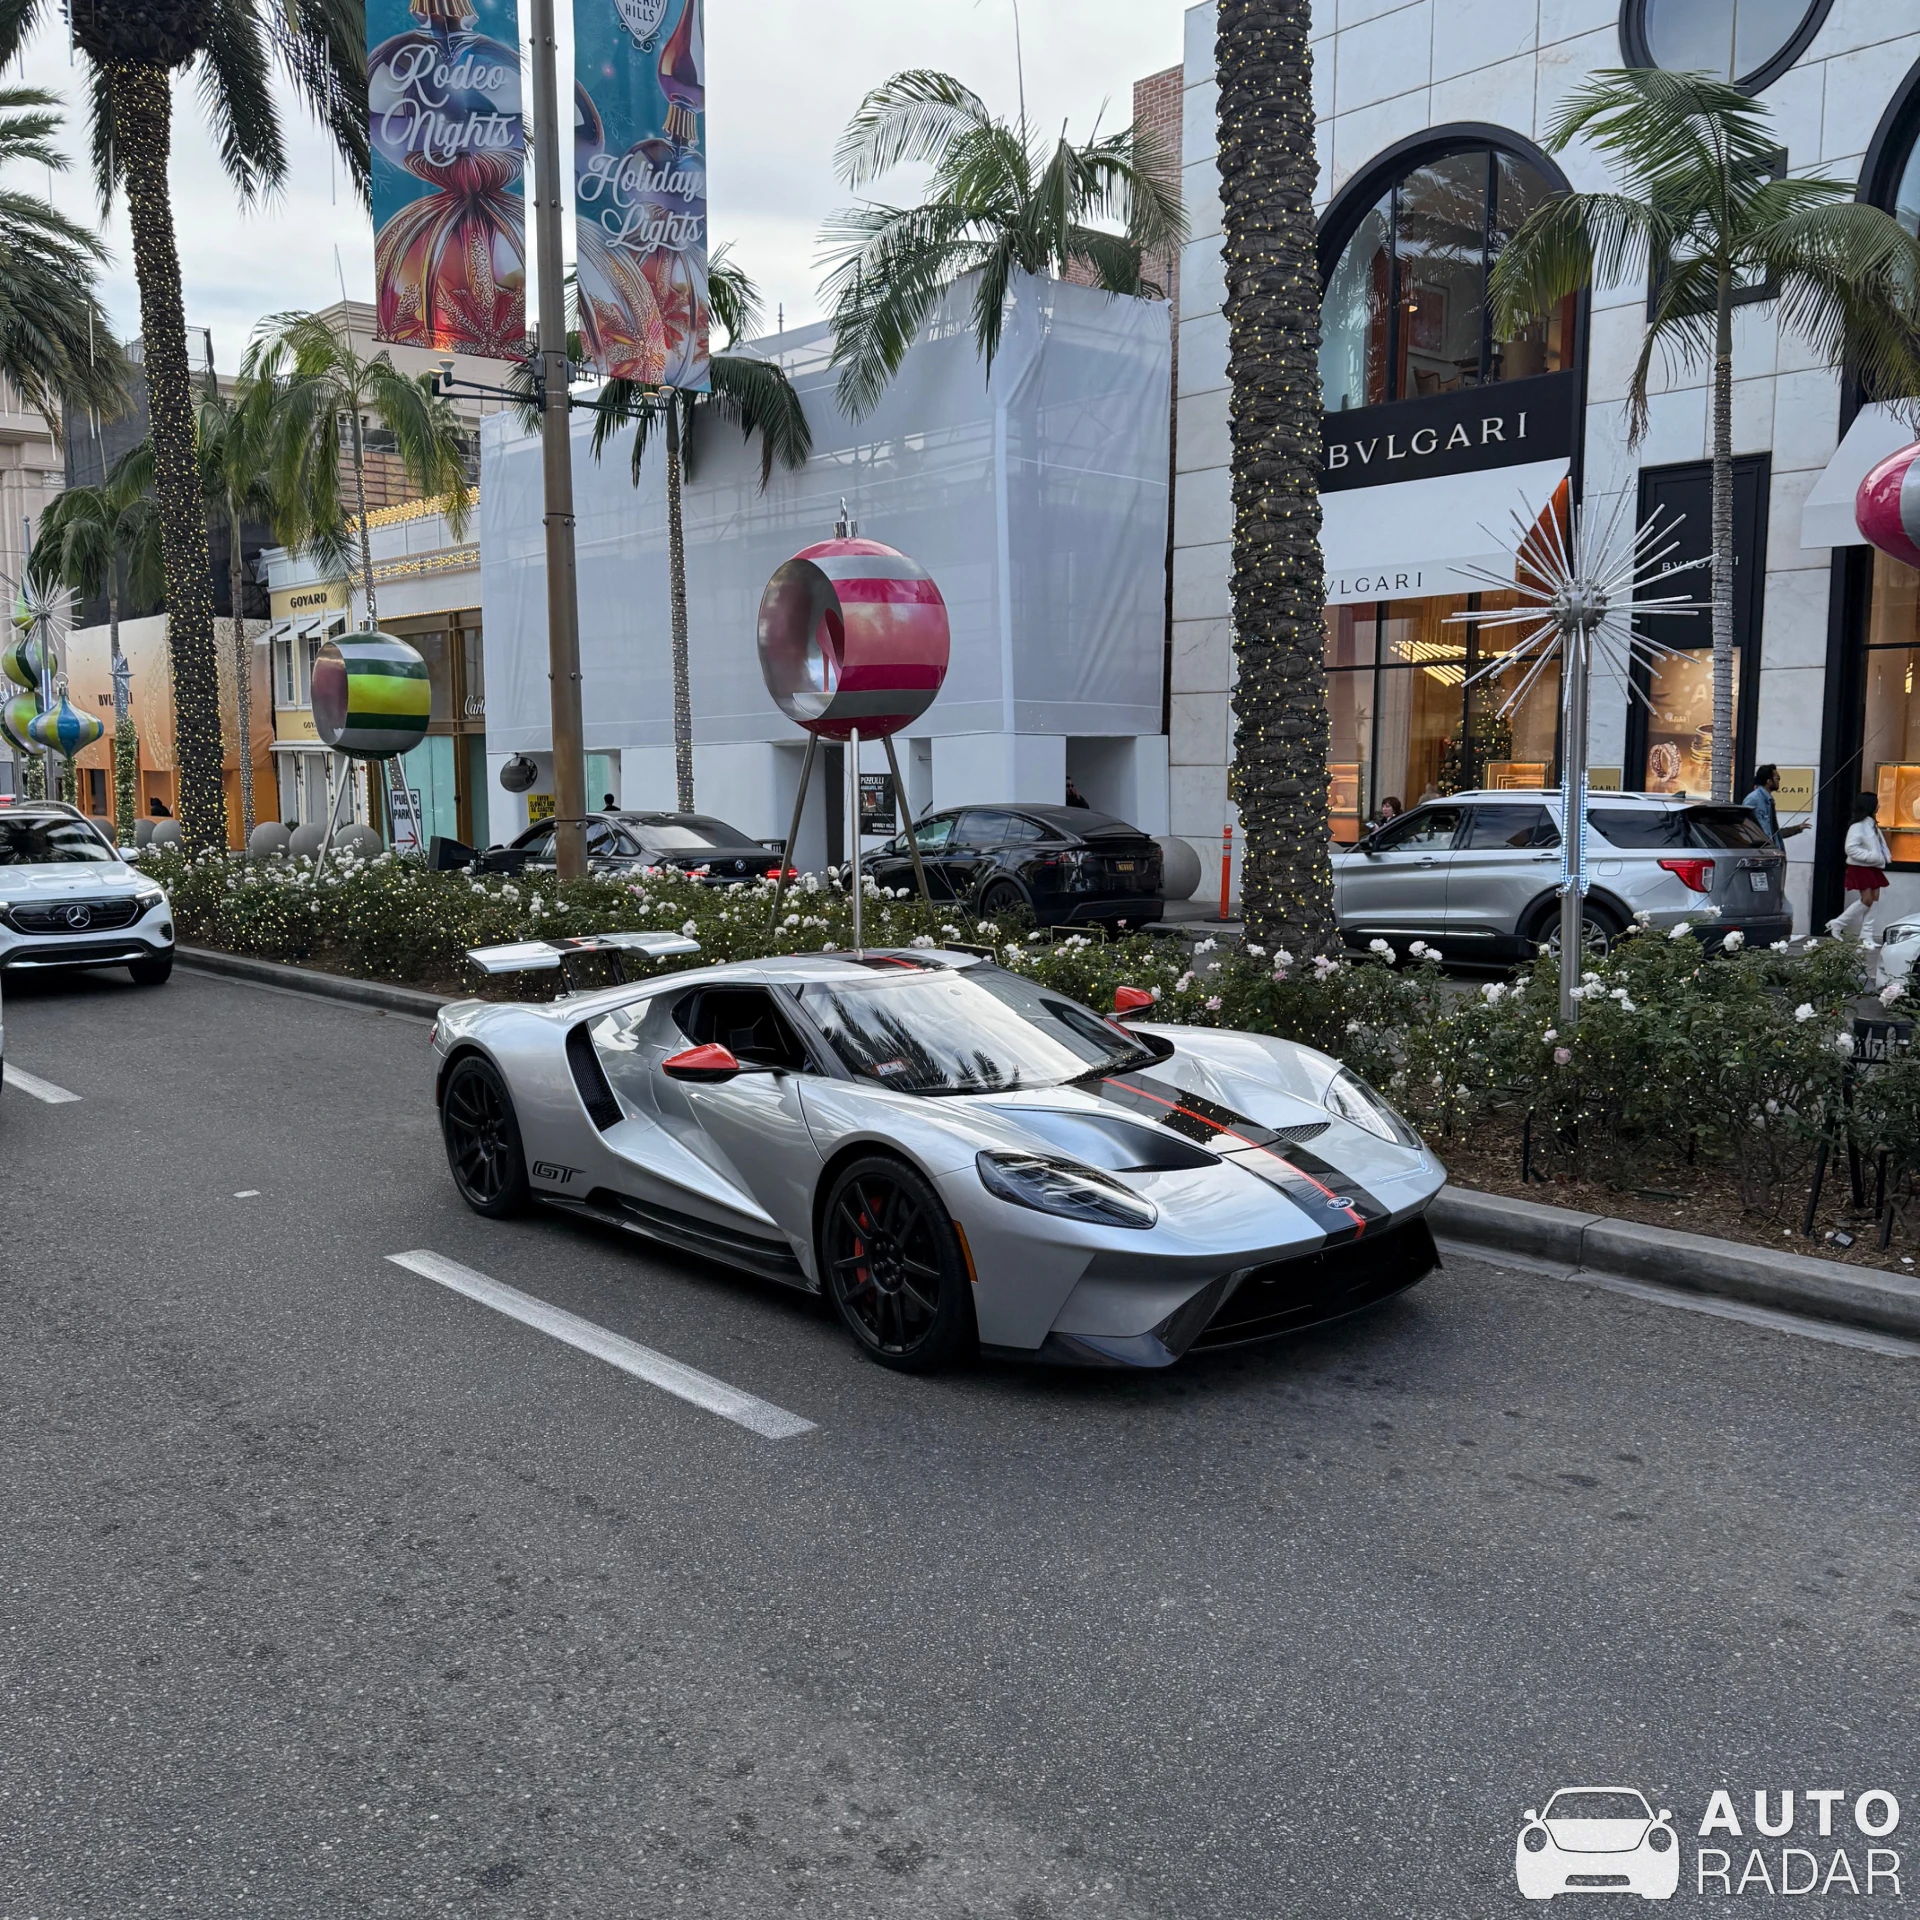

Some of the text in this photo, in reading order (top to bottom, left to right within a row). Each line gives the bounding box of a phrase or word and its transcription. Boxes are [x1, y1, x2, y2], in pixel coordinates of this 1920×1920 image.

[625, 3, 655, 23] HILLS
[386, 43, 507, 108] Rodeo
[381, 98, 517, 168] Nights
[577, 153, 702, 208] Holiday
[601, 203, 705, 253] Lights
[1328, 411, 1528, 470] BVLGARI
[290, 592, 328, 609] GOYARD
[1322, 571, 1422, 596] VLGARI
[98, 691, 134, 706] BVLI
[532, 1160, 587, 1184] GT
